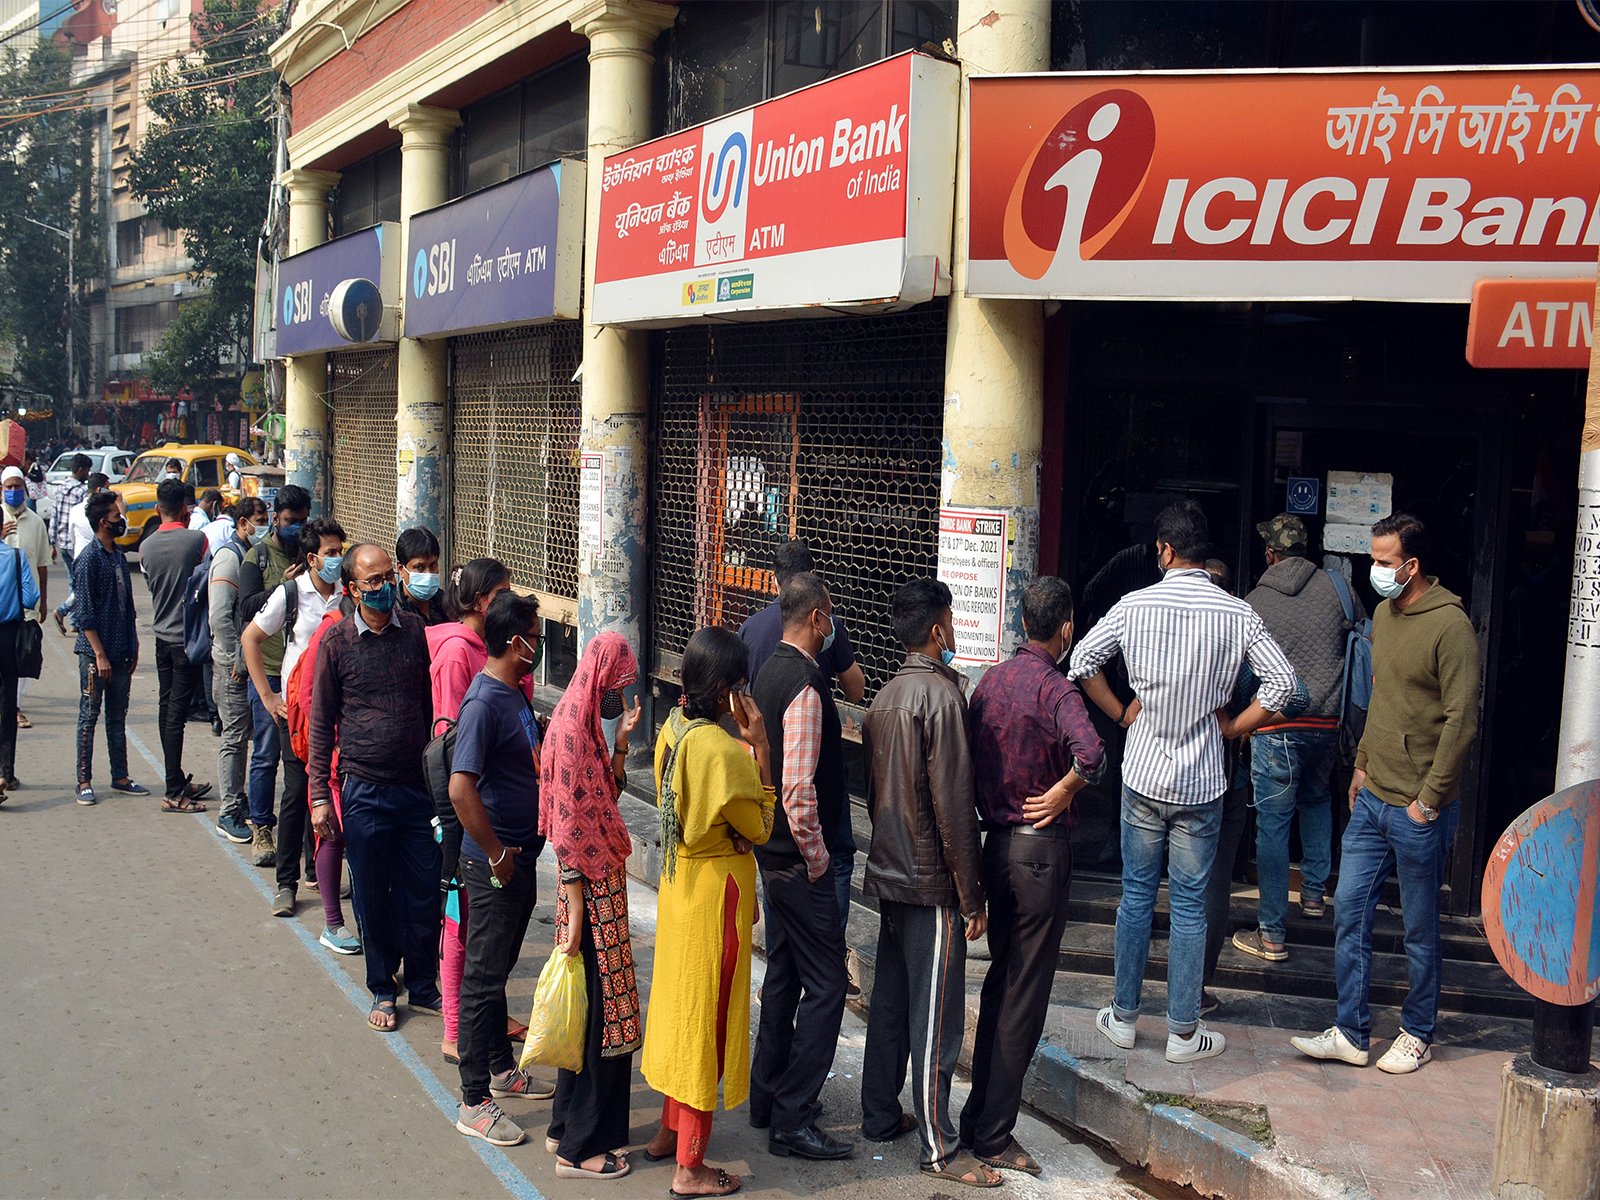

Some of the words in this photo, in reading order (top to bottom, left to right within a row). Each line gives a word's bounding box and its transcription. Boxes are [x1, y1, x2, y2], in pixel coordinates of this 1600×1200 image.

[753, 133, 825, 187] Union
[829, 104, 906, 168] Bank
[846, 171, 863, 200] of
[864, 164, 901, 196] India
[614, 202, 666, 239] यूनियन
[666, 190, 693, 219] बैंक
[1151, 176, 1390, 245] ICICI
[705, 230, 737, 261] एटीएम
[748, 223, 785, 252] ATM
[497, 246, 522, 283] एटीएम
[524, 244, 547, 274] ATM
[658, 239, 690, 266] এটিএম
[427, 238, 456, 297] SBI
[466, 252, 493, 286] এটিএম
[293, 278, 313, 325] SBI
[1497, 302, 1593, 347] ATM
[975, 520, 1000, 534] STRIKE
[964, 539, 979, 552] Dec.
[980, 540, 998, 553] 2021
[950, 570, 979, 581] OPPOSE
[977, 557, 999, 569] officers
[963, 584, 973, 597] OF
[974, 586, 998, 599] BANKS
[951, 600, 971, 613] ANKING
[971, 601, 997, 615] REFORMS
[952, 617, 980, 628] DRAW
[959, 644, 974, 655] BANK
[973, 646, 996, 657] UNIONS
[985, 632, 996, 643] BILL
